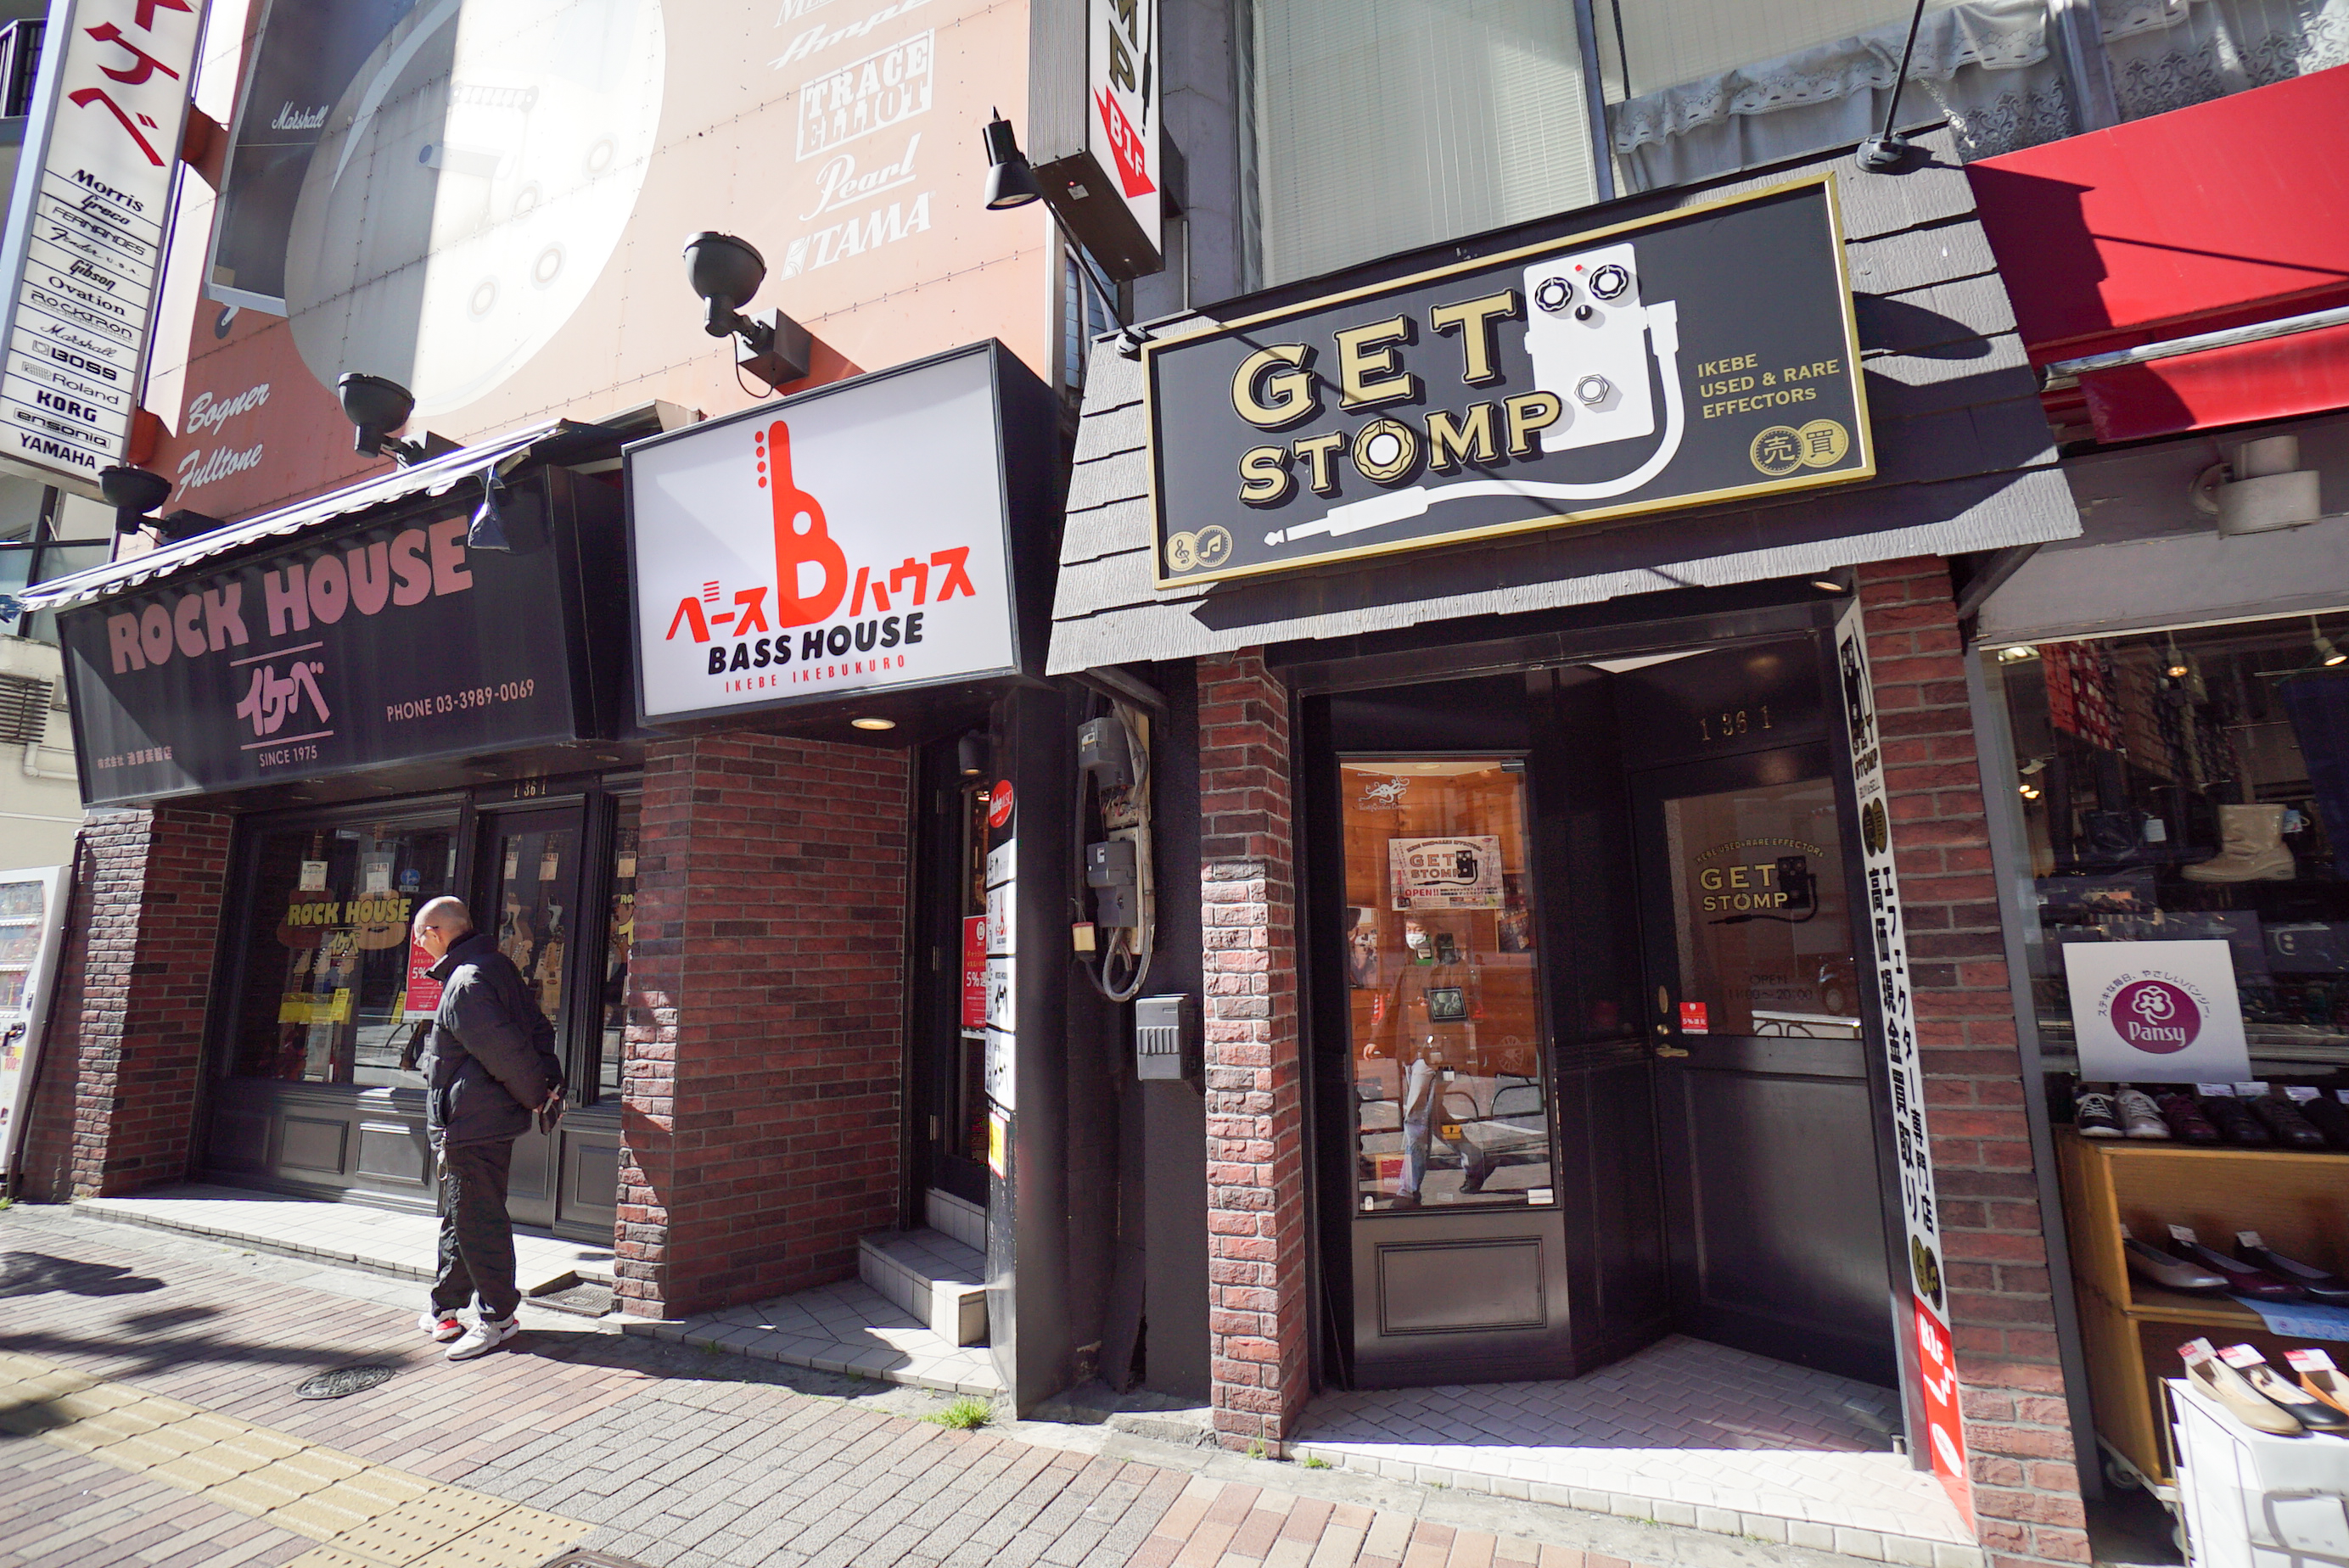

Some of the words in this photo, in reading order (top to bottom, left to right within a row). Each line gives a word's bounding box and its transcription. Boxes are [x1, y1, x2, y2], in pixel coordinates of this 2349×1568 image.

[806, 40, 928, 120] TRACE
[271, 100, 328, 129] Marshall
[800, 76, 927, 156] ELLIOT
[1110, 100, 1144, 177] B1F
[71, 169, 144, 213] Morris
[799, 132, 921, 221] Pearl
[81, 193, 131, 226] Greco
[49, 227, 104, 257] Fender
[52, 206, 146, 256] FERNANDES
[809, 193, 932, 271] TAMA
[69, 259, 116, 292] Gibson
[48, 276, 126, 317] Ovation
[40, 324, 118, 358] Marshall
[1231, 288, 1520, 428] GET
[51, 347, 117, 382] BOSS
[1697, 353, 1758, 378] IKEBE
[1700, 375, 1756, 399] USED
[1762, 372, 1777, 387] &
[1783, 358, 1841, 383] RARE
[36, 389, 98, 423] KORG
[53, 372, 120, 406] Roland
[1702, 387, 1818, 420] EFFECTORS
[186, 383, 271, 436] Bogner
[20, 432, 97, 469] YAMAHA
[1238, 389, 1562, 503] STOMP
[1763, 435, 1796, 464] 売
[1806, 428, 1836, 458] 買
[174, 443, 263, 502] Fulltone
[107, 584, 249, 675] ROCK
[263, 514, 474, 637] HOUSE
[849, 546, 977, 618] ハウス
[708, 635, 792, 675] BASS
[801, 612, 924, 661] HOUSE
[726, 673, 777, 693] IKEBE
[793, 654, 905, 683] IKEBUKURO
[236, 660, 332, 737] イケベ
[386, 698, 433, 723] PHONE
[435, 679, 535, 714] 03-3989-0069
[259, 748, 290, 768] SINCE
[293, 744, 318, 762] 1975
[1410, 854, 1455, 867] GET
[1410, 868, 1460, 879] STOMP
[1700, 863, 1776, 891] GET
[288, 902, 340, 927] ROCK
[345, 898, 412, 924] HOUSE
[1703, 893, 1788, 911] STOMP
[2128, 1021, 2187, 1047] Pansy
